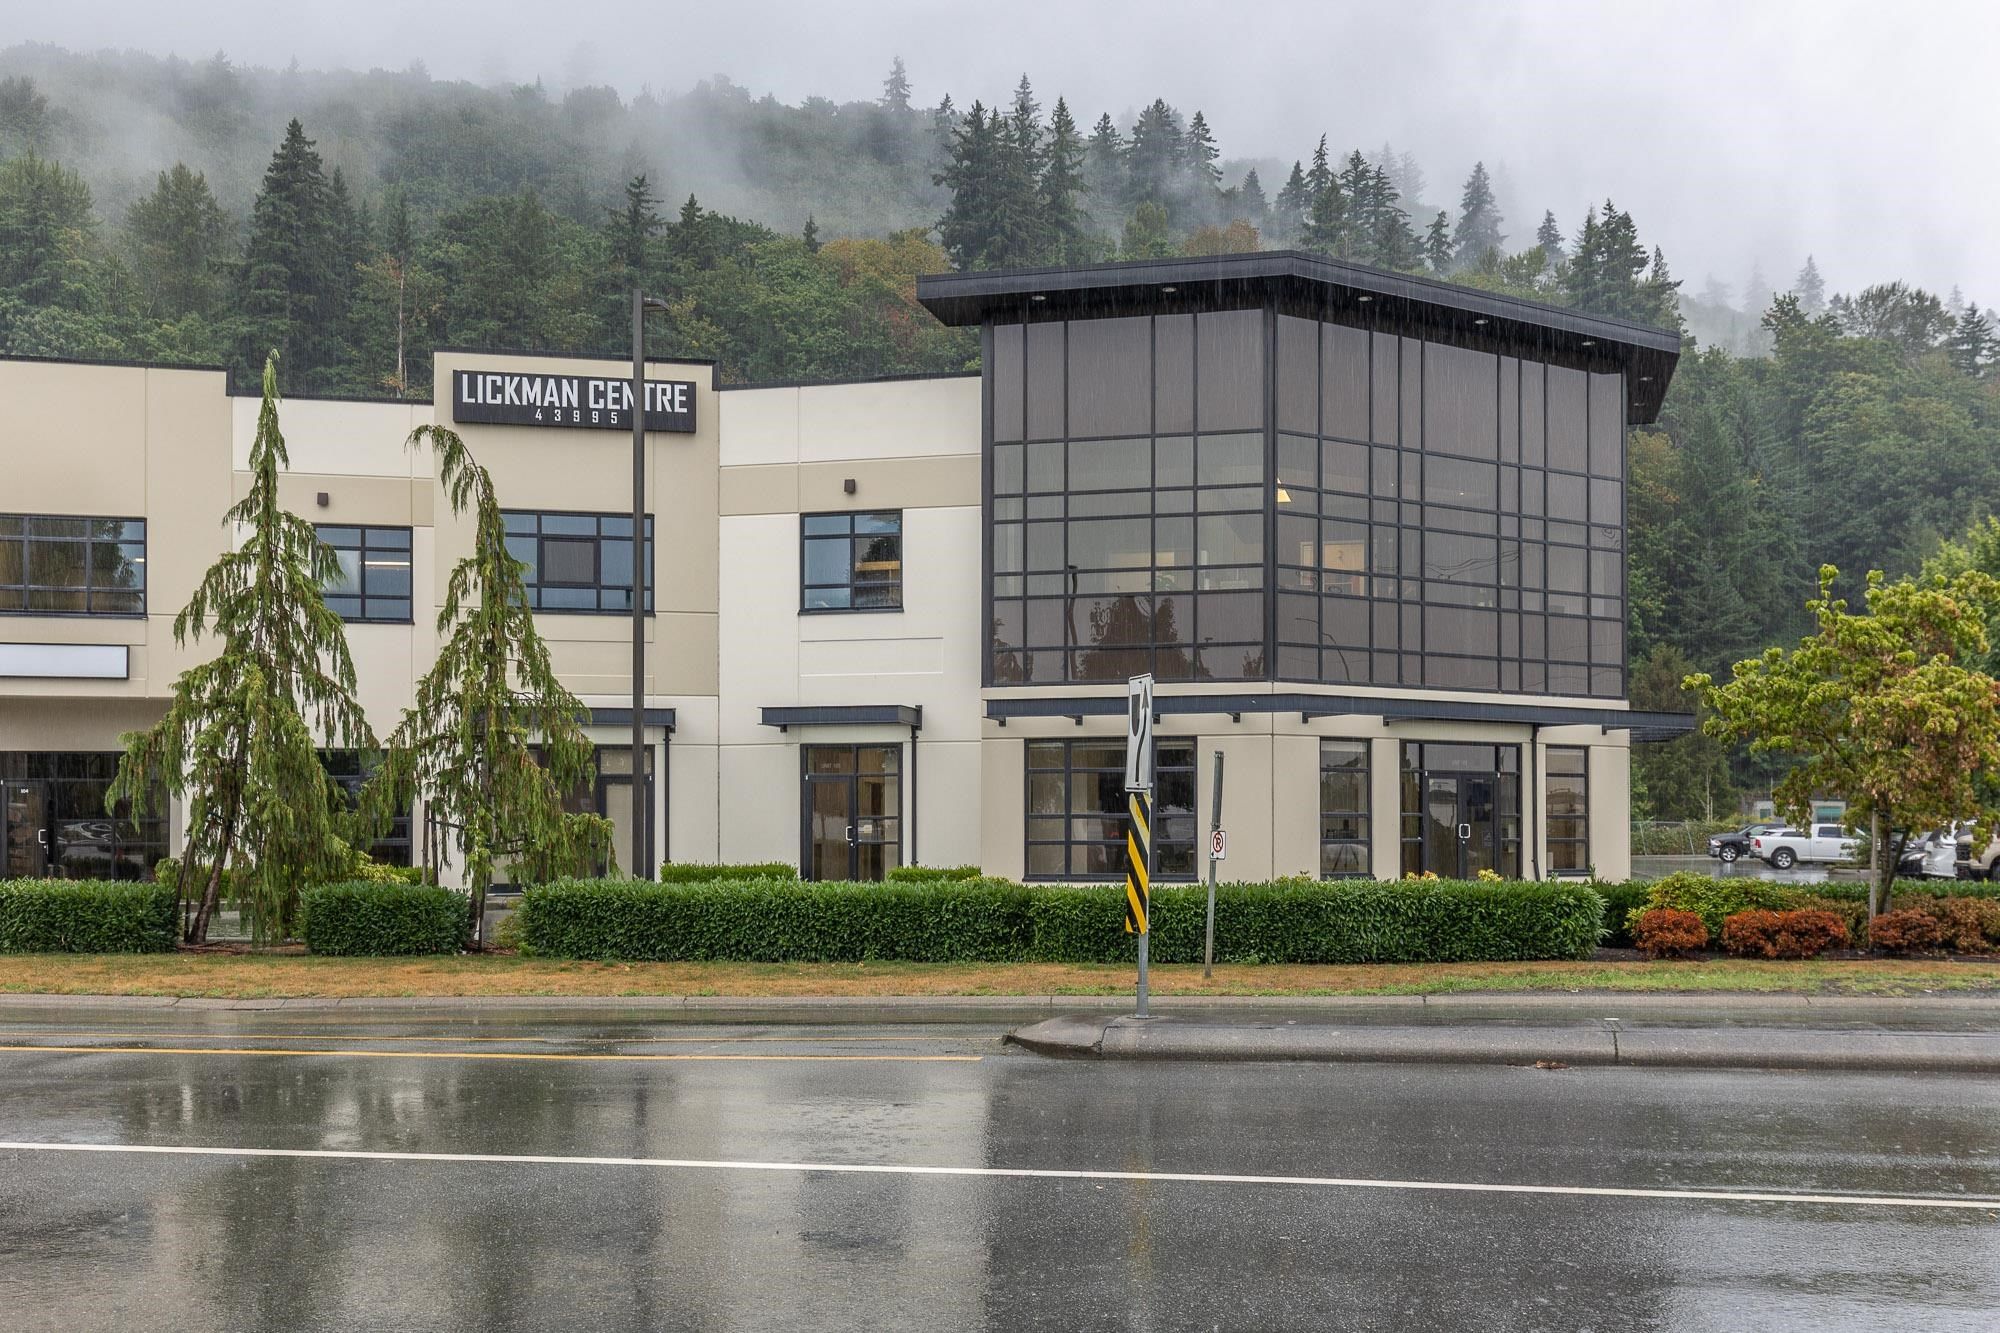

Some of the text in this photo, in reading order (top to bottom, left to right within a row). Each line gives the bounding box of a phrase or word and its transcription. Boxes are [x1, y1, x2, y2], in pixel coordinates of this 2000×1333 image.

[462, 373, 688, 413] LICKMAN CENTRE
[535, 409, 618, 424] 43995
